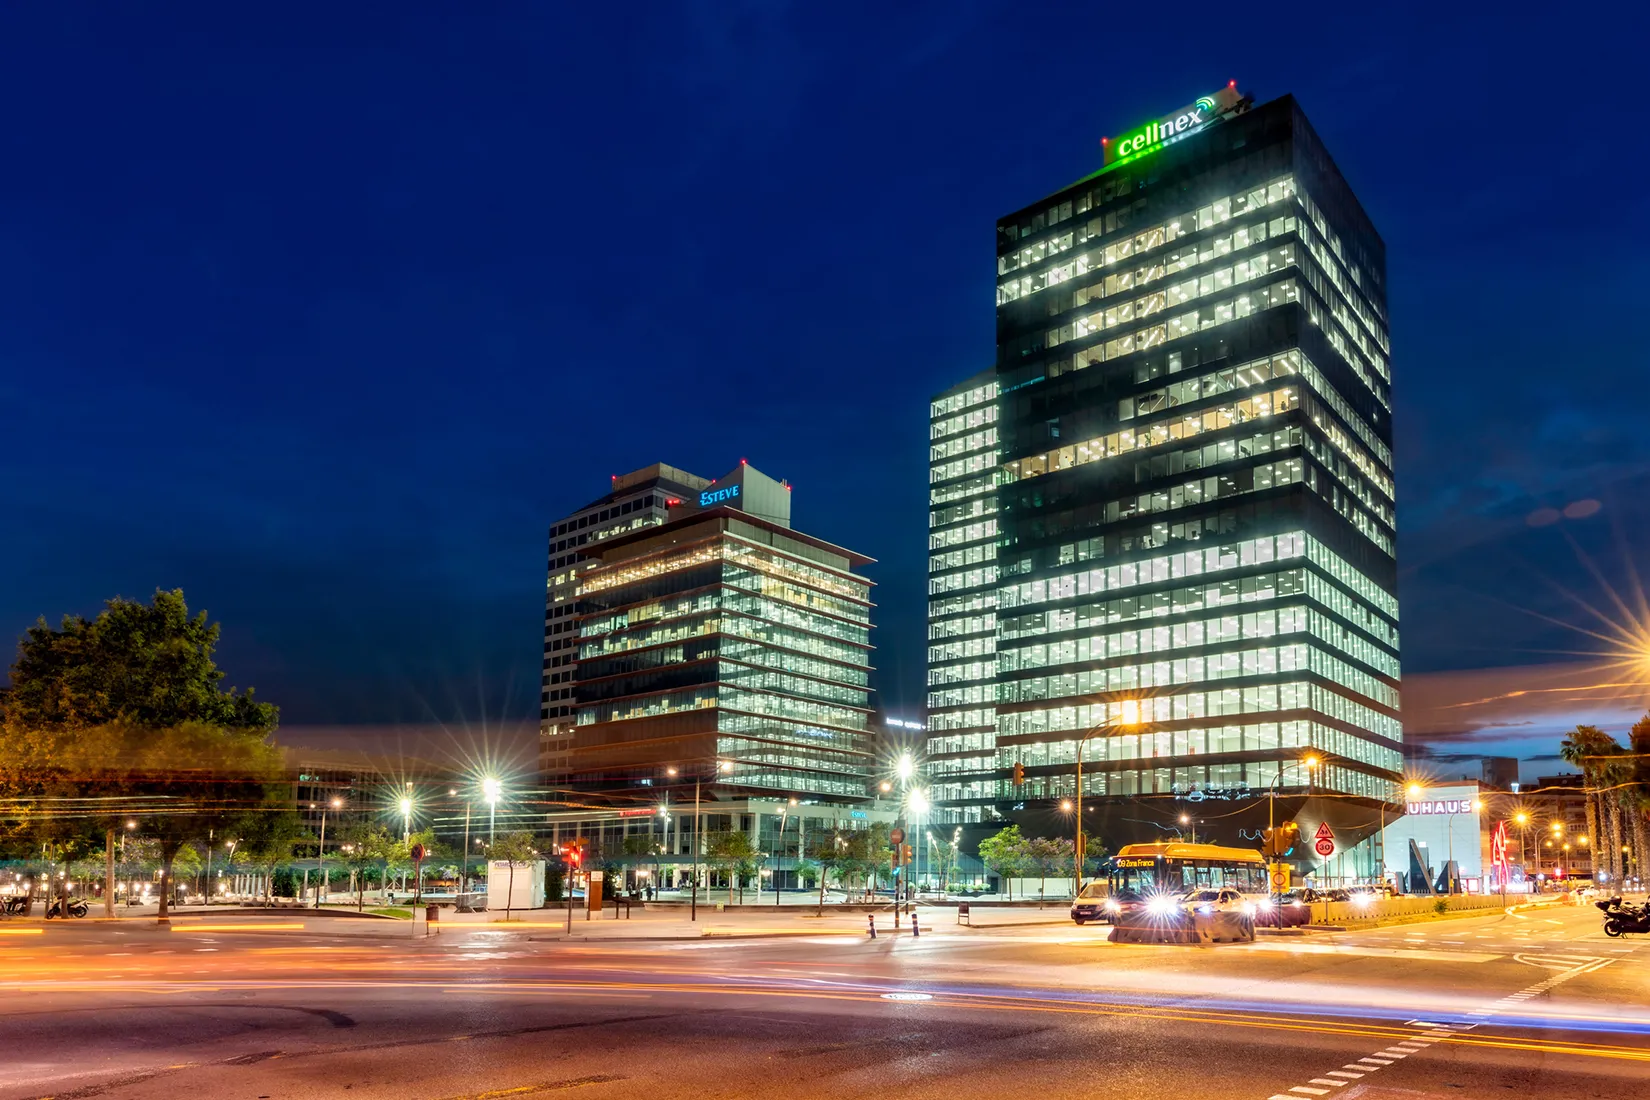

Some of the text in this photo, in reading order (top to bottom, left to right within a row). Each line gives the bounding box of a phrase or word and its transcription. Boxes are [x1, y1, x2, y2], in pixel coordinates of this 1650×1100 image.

[1119, 107, 1203, 156] cellnex
[1405, 800, 1472, 814] UHAUS
[1319, 843, 1331, 851] 30
[1126, 859, 1137, 868] Zona
[1137, 858, 1155, 867] Franca
